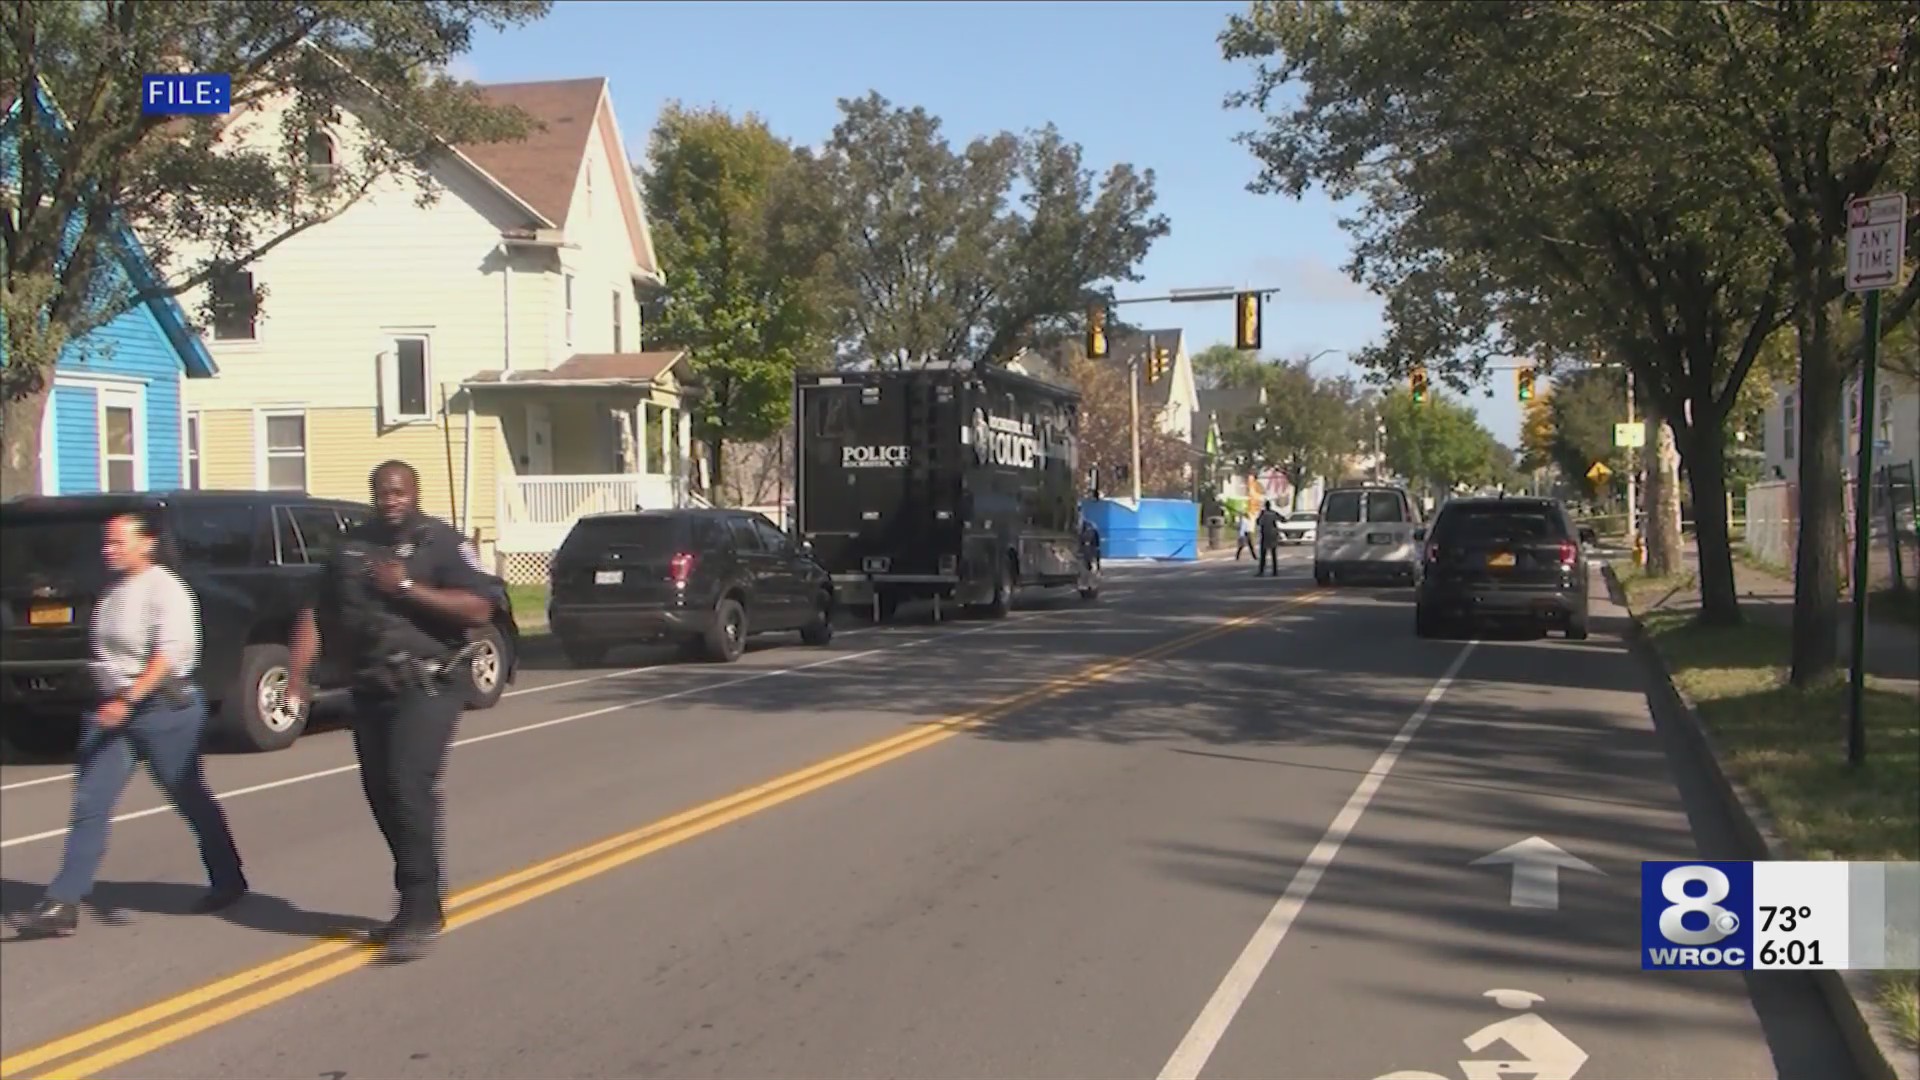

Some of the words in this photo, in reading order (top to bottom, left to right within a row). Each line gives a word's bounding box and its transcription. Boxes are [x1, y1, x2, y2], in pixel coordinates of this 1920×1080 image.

[1859, 229, 1891, 249] ANY
[1856, 249, 1893, 270] TIME
[842, 445, 911, 461] POLICE
[988, 431, 1035, 468] POLICE
